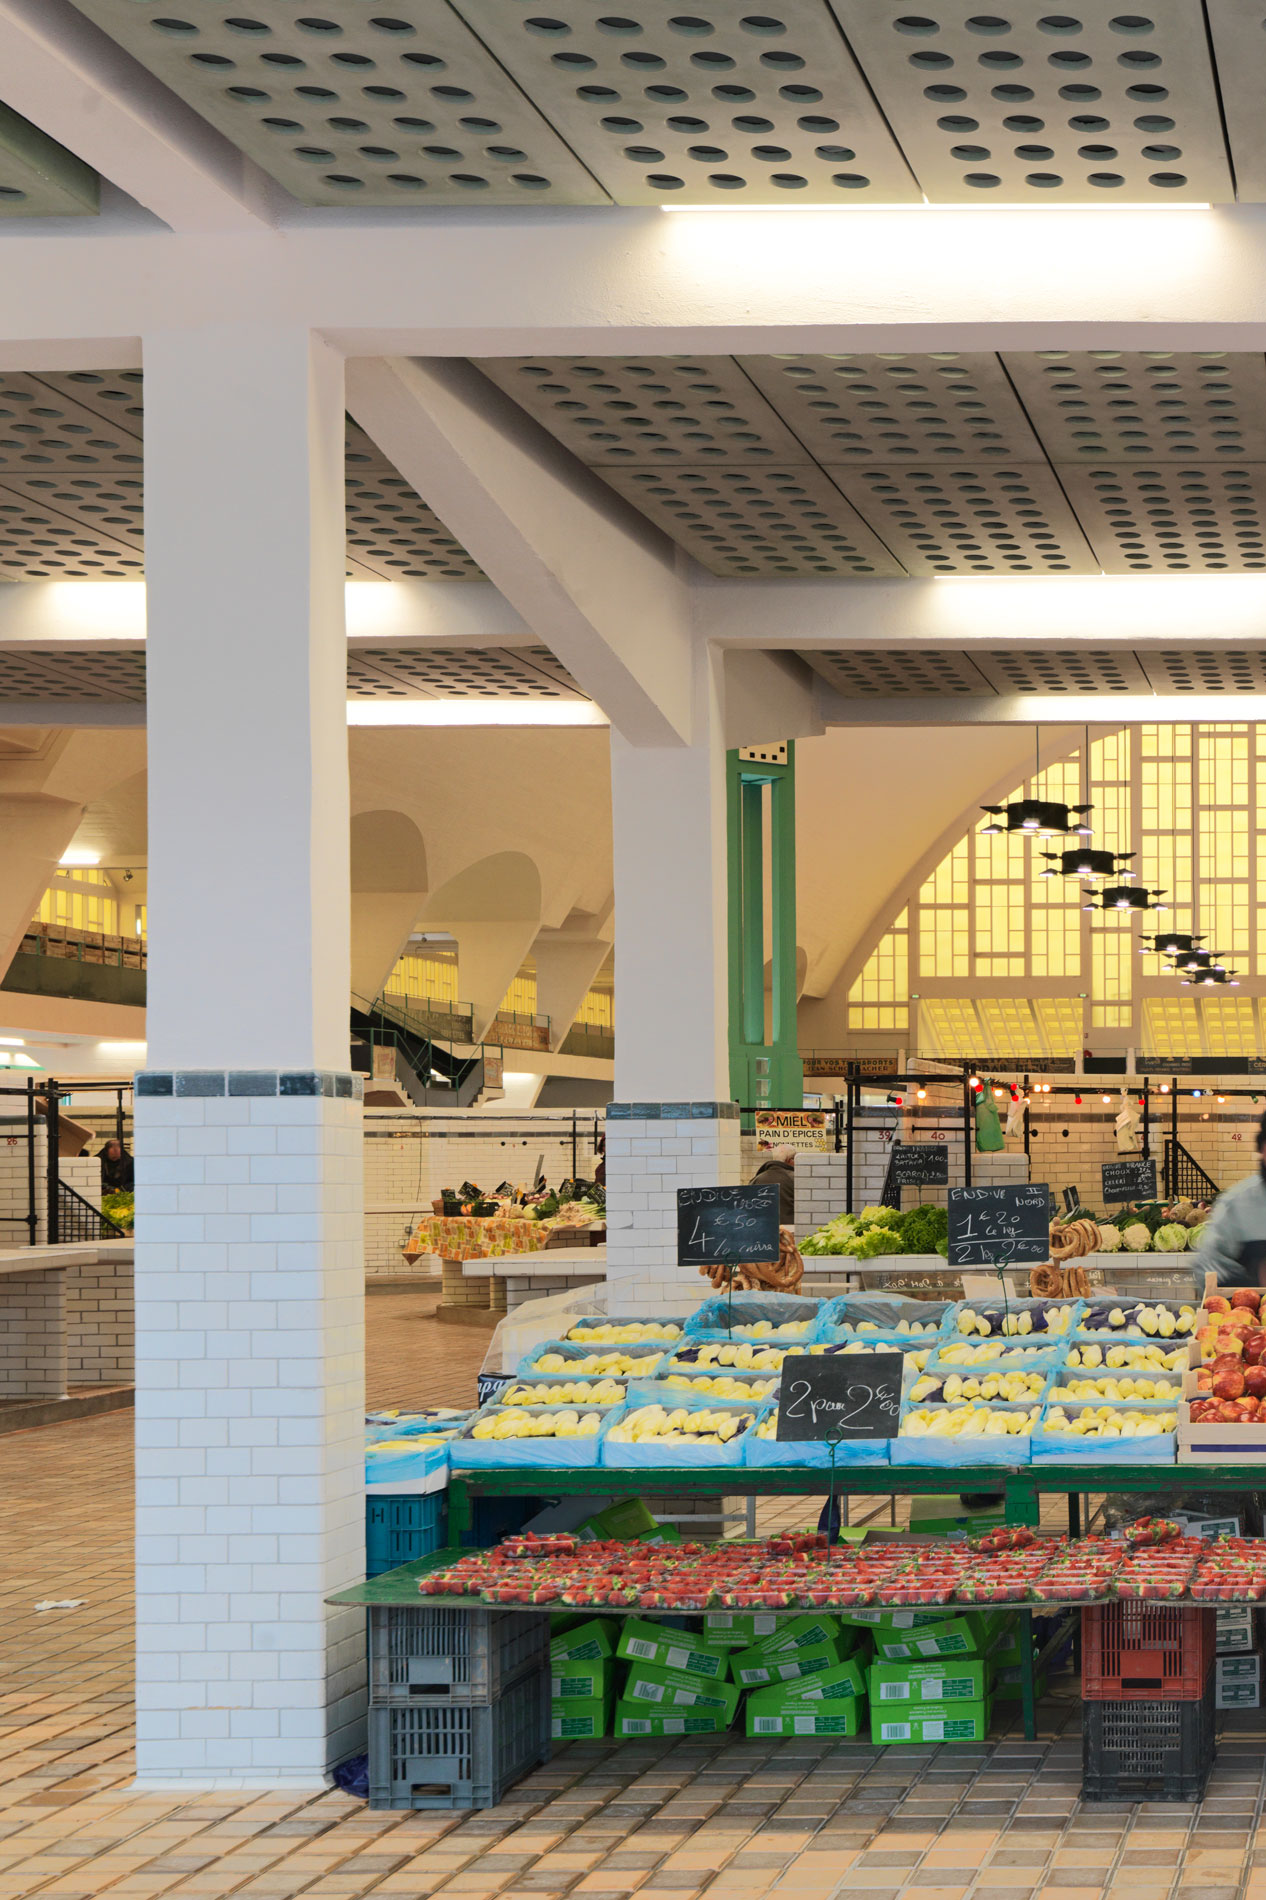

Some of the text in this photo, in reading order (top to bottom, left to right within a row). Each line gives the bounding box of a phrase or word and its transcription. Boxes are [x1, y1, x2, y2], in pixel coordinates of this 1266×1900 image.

[776, 1116, 807, 1126] MIEL
[878, 1131, 891, 1140] 39
[931, 1131, 945, 1140] 40
[786, 1380, 812, 1417] 2
